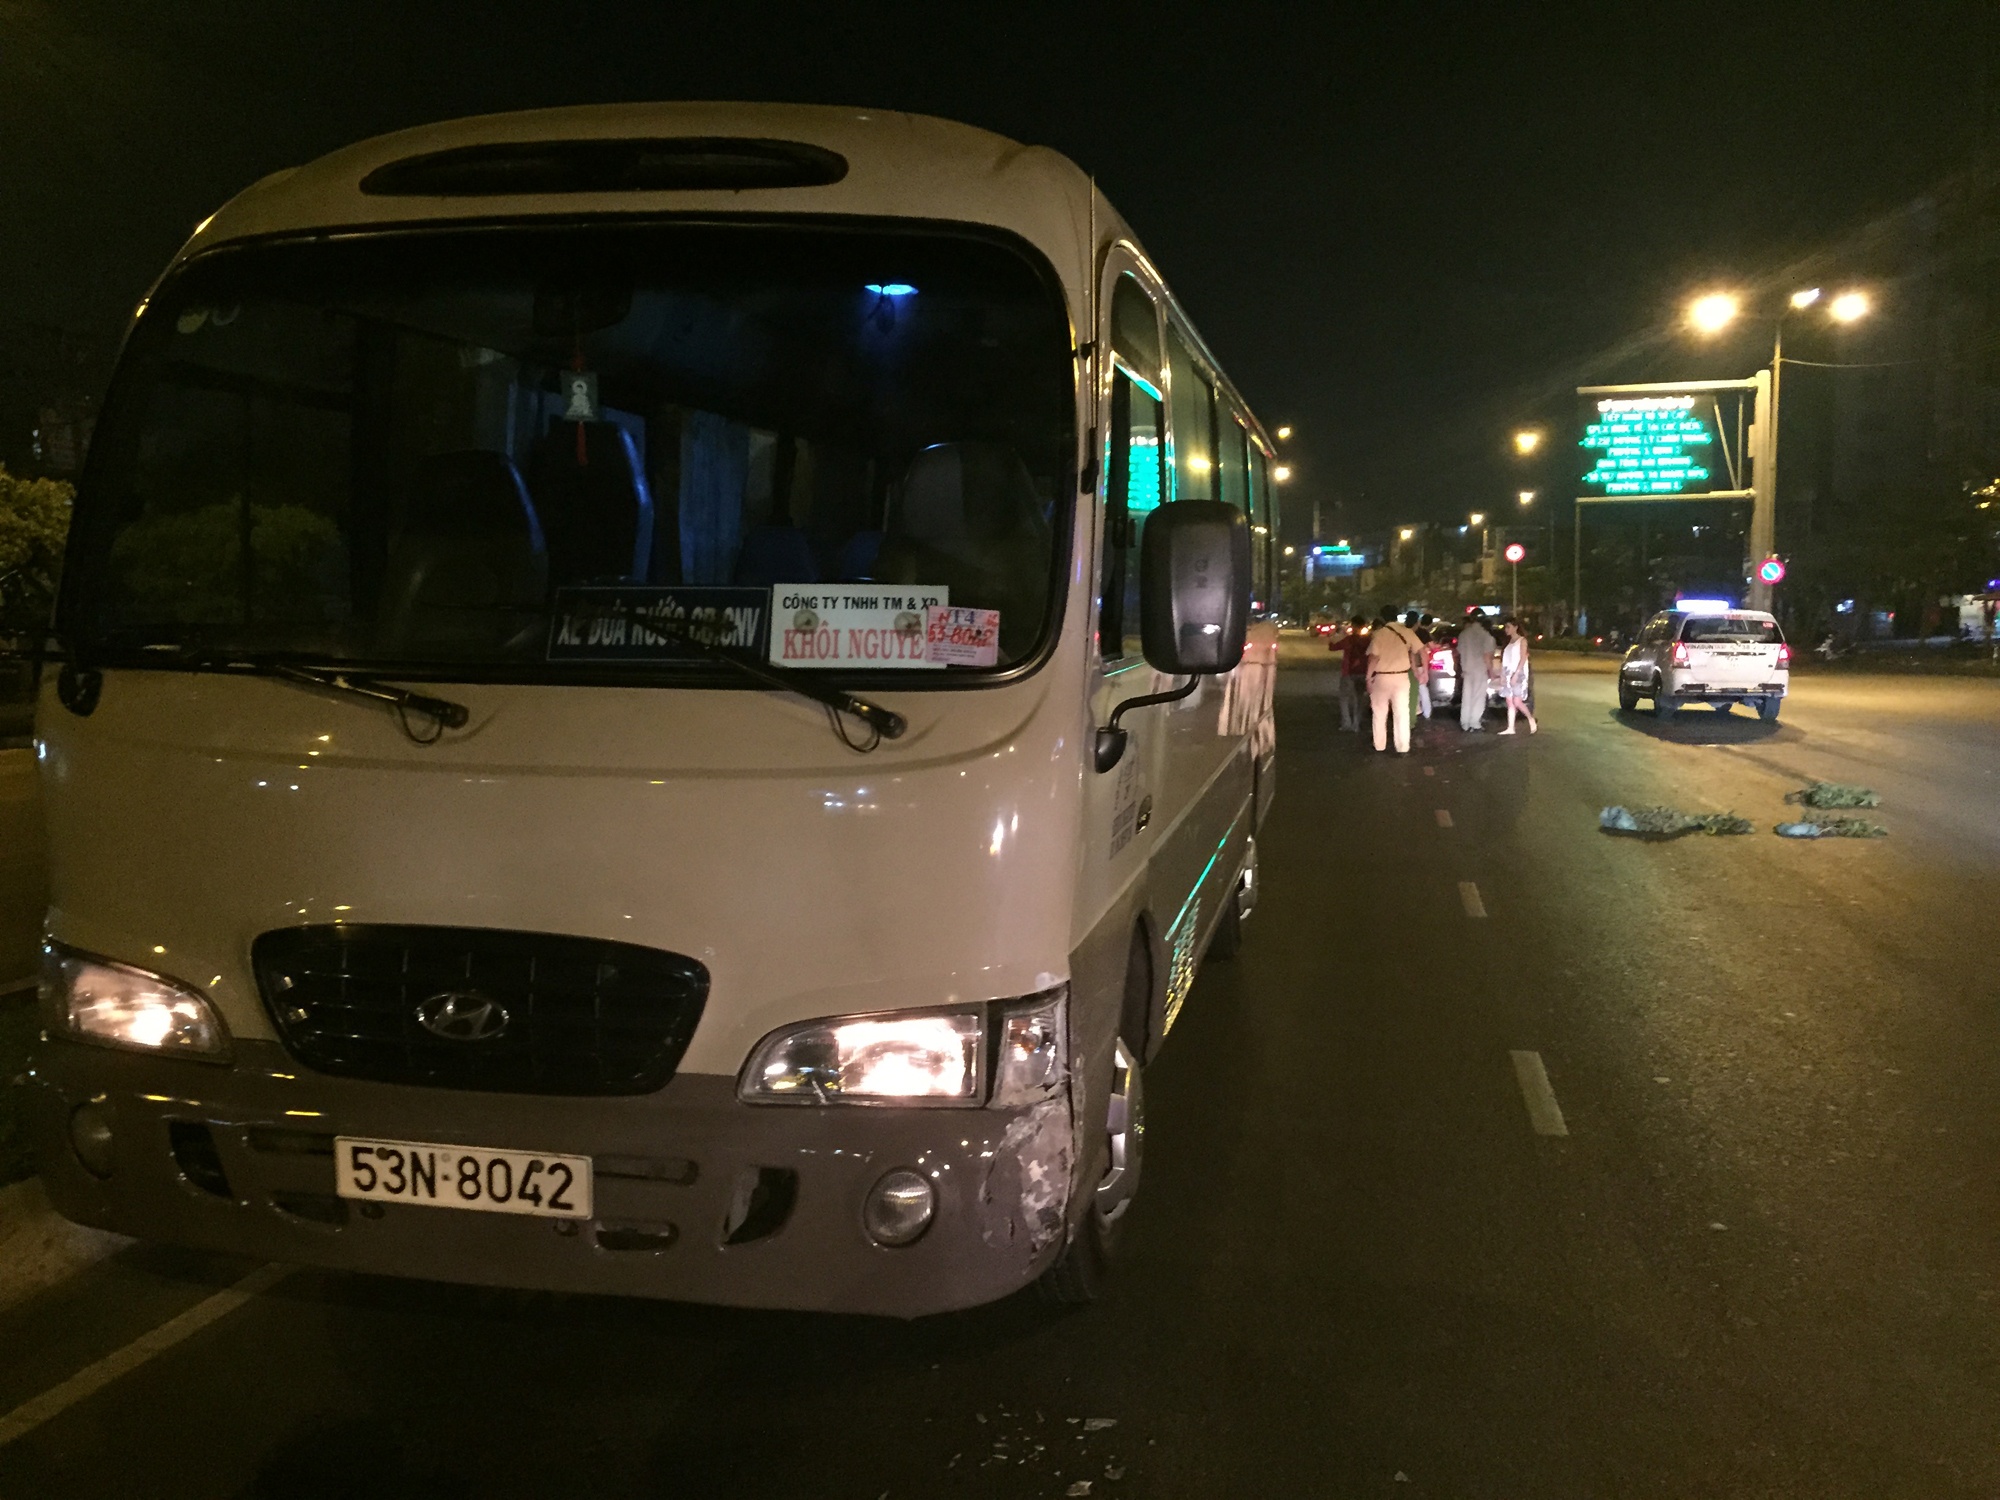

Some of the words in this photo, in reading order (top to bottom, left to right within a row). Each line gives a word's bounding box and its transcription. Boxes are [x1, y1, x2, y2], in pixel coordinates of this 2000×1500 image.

[782, 593, 818, 610] CÔNG
[823, 596, 839, 609] TY
[844, 596, 878, 609] TNHH
[884, 596, 902, 610] TM
[907, 597, 916, 610] &
[782, 620, 840, 659] KHÔI
